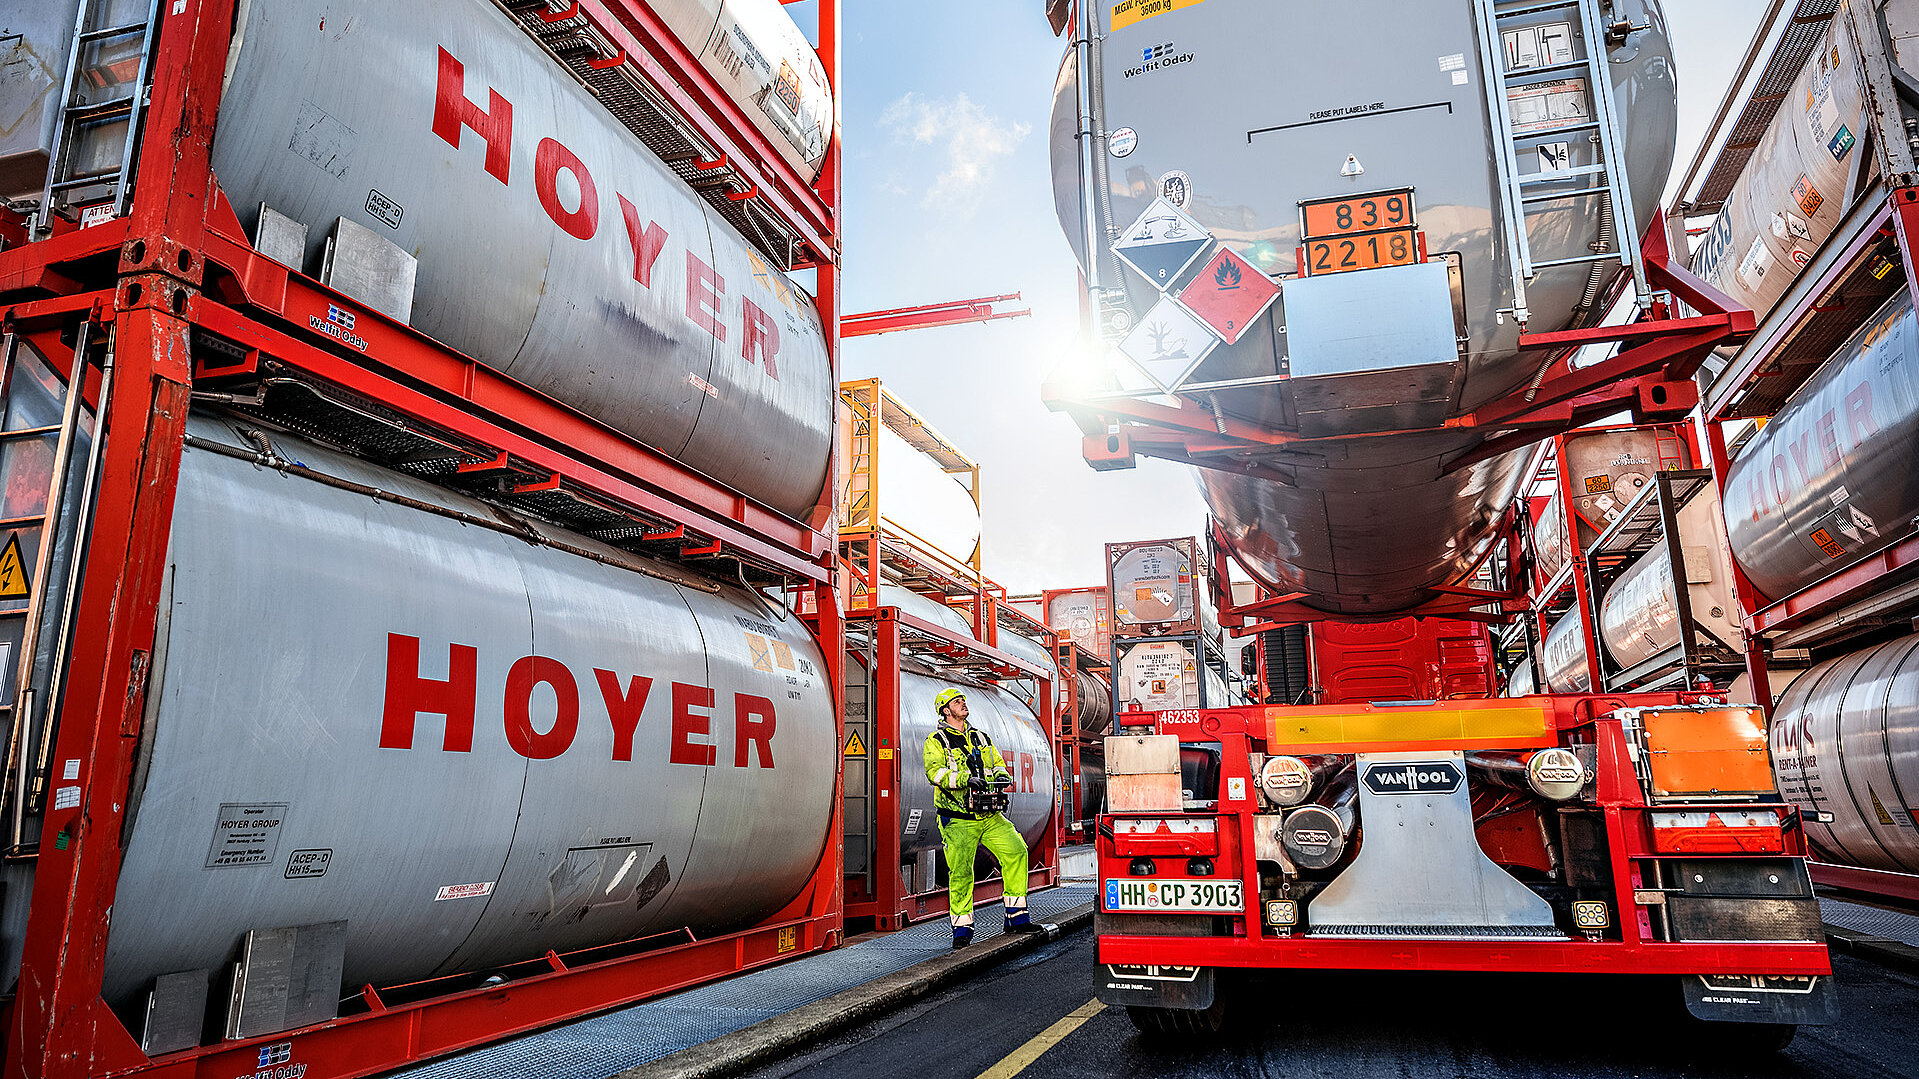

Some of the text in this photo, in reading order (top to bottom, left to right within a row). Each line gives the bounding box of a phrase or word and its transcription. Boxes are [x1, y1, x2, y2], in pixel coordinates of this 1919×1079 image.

[1141, 0, 1172, 16] 36000 kg
[1123, 52, 1195, 79] Welfit Oddy
[778, 81, 798, 111] 2250
[1309, 102, 1385, 120] PLEASE PUT LABELS HERE
[1832, 131, 1851, 156] MTK
[88, 205, 115, 218] ATTEN
[371, 195, 401, 217] ACEP-D
[432, 44, 782, 382] HOYER
[1336, 197, 1404, 230] 839
[1802, 191, 1821, 215] 3428
[1314, 234, 1408, 270] 2218
[1158, 268, 1167, 278] 8
[310, 315, 368, 352] Welfit Oddy
[1226, 320, 1235, 330] 3
[1747, 380, 1881, 524] HOYER
[1549, 628, 1576, 668] HOYER
[379, 632, 777, 770] HOYER
[1160, 710, 1200, 725] 462353
[1775, 712, 1815, 754] TWS
[221, 820, 279, 829] HOYER GROUP
[220, 848, 265, 857] Emergency Number
[292, 853, 329, 865] ACEP-D
[288, 864, 311, 875] HH15
[1110, 896, 1116, 904] D
[1120, 883, 1240, 907] HH CP 3903
[236, 1062, 308, 1079] lfit Oddy
